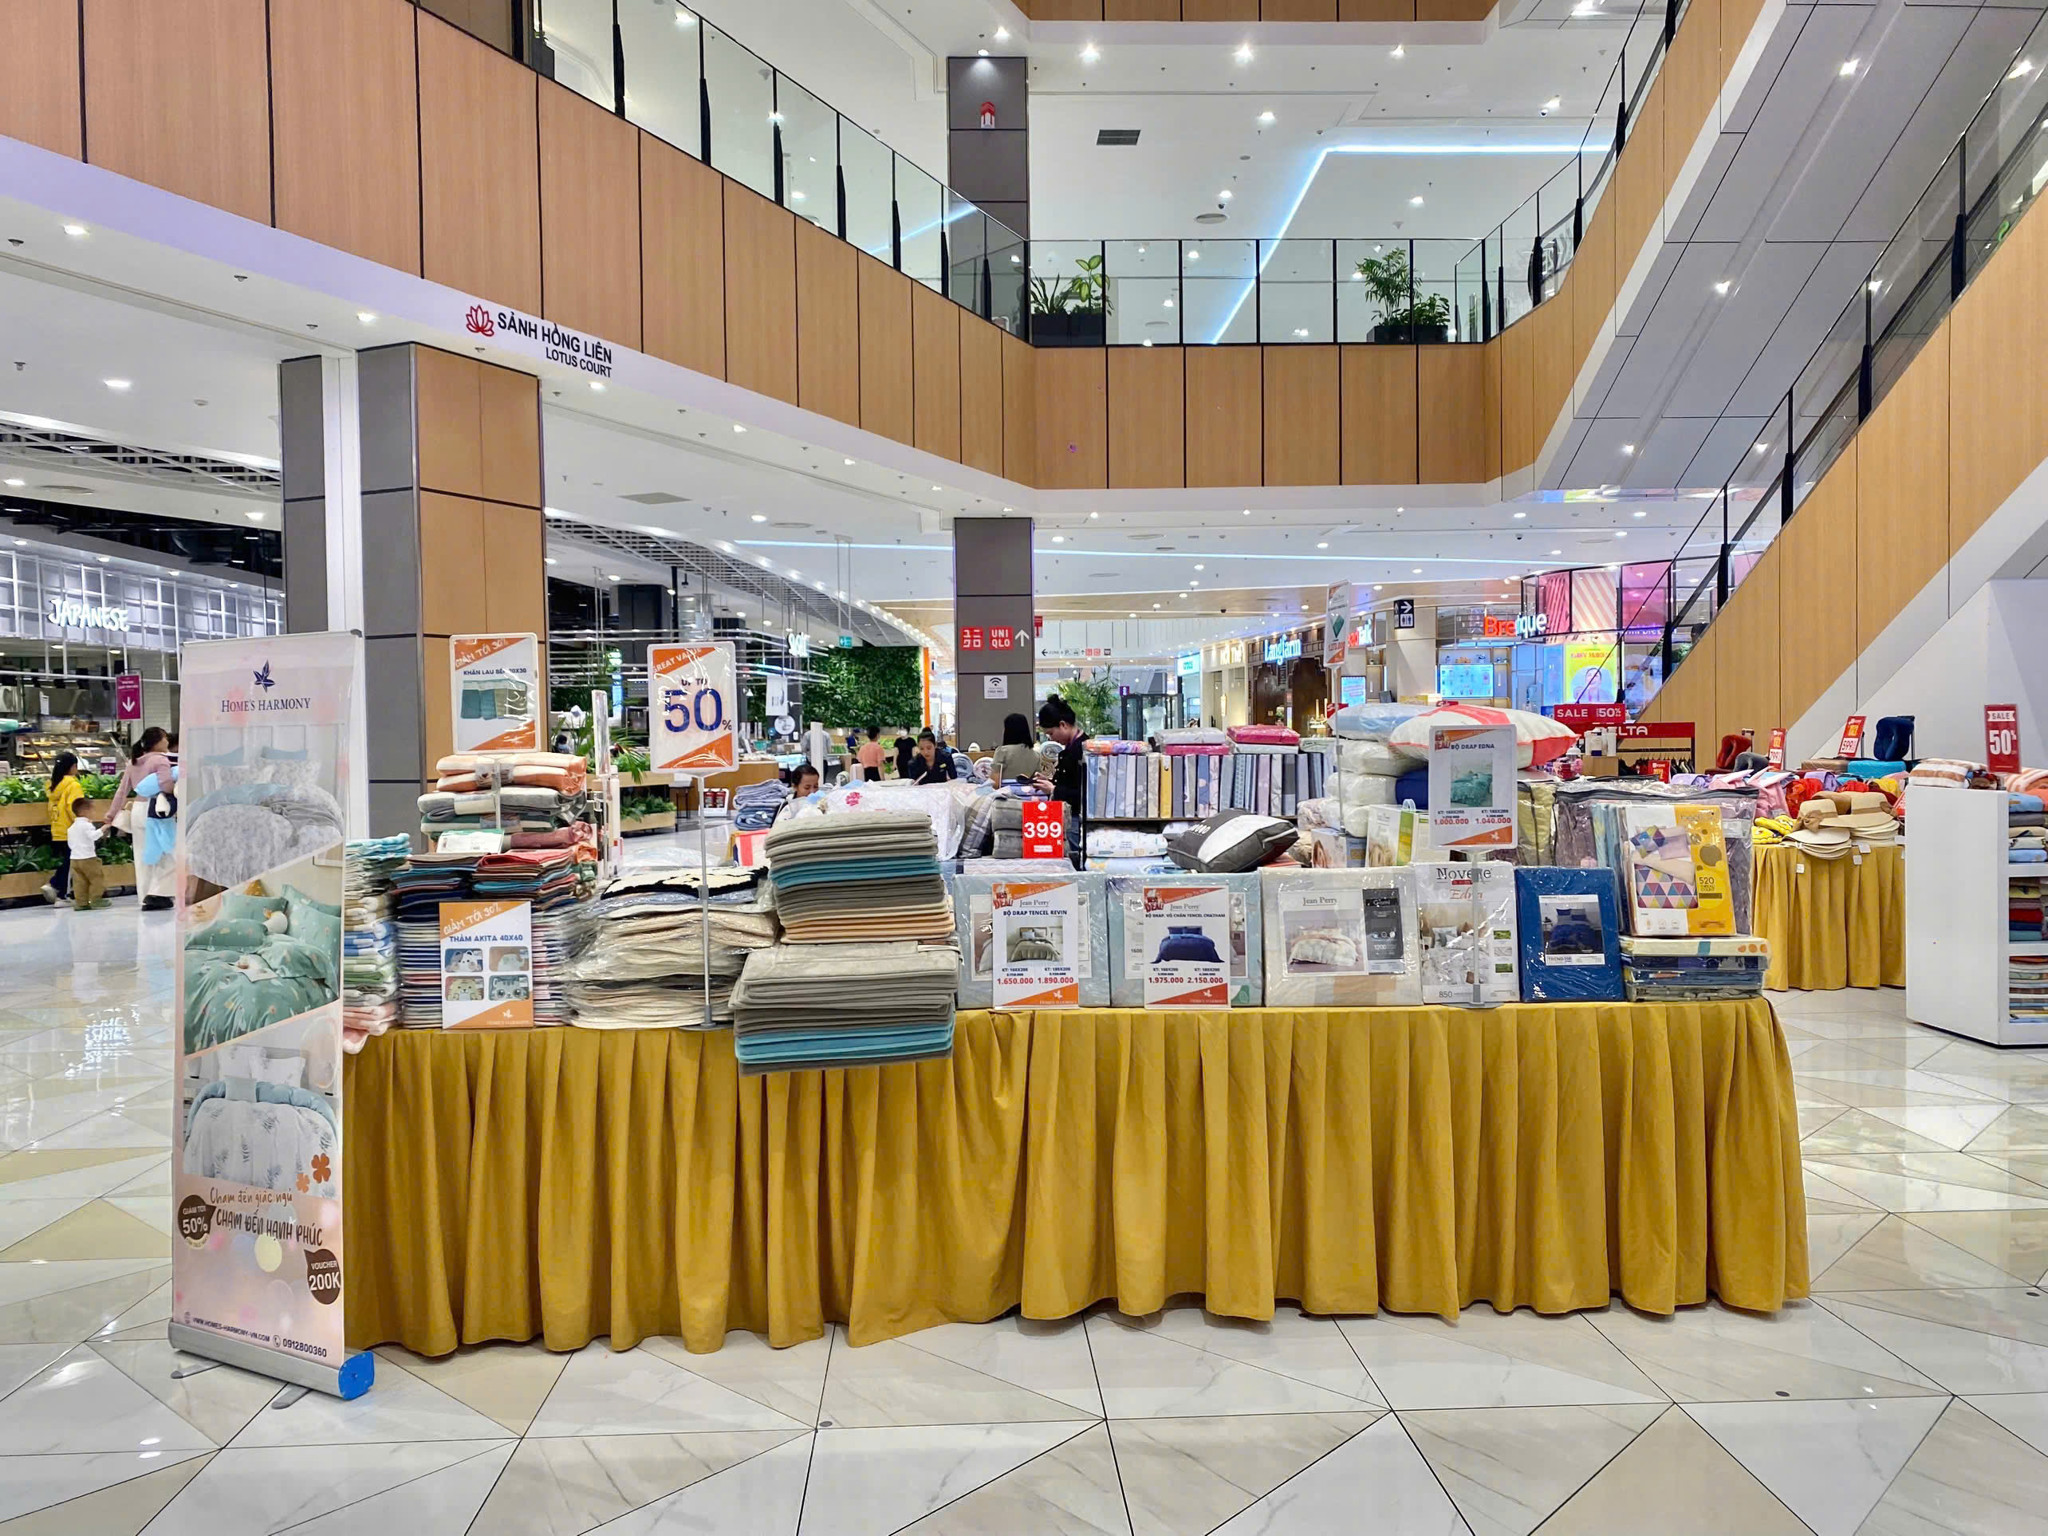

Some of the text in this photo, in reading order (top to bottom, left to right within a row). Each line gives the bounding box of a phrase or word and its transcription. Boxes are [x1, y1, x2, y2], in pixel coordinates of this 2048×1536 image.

[497, 311, 612, 364] SẢNH HỒNG LIÊN
[545, 346, 612, 378] LOTUS COURT
[47, 598, 130, 632] JAPANESE
[991, 629, 1009, 638] UNI
[991, 640, 1011, 649] QLO
[1264, 634, 1302, 665] Langfarm
[653, 657, 676, 673] GREAT
[695, 678, 708, 686] TO
[221, 697, 311, 713] HOME'S HARMONY
[664, 687, 733, 733] 50%
[1556, 708, 1589, 718] SALE
[1991, 712, 2010, 720] SALE
[1989, 729, 2017, 755] 50%
[1023, 821, 1062, 839] 399
[1698, 876, 1715, 885] 520
[1302, 898, 1318, 906] Jean
[443, 918, 465, 935] GIẢM
[465, 908, 482, 925] TỚI
[449, 933, 524, 943] THẢM AKITA 40X60
[997, 977, 1034, 985] 1.650.000
[1037, 976, 1074, 984] 1.890.000
[1148, 976, 1184, 984] 1.975.000
[1187, 976, 1223, 984] 2.150.000
[182, 1217, 209, 1235] 50%
[216, 1208, 324, 1247] CHẠM ĐẾN HẠNH PHÚC
[310, 1260, 338, 1271] VOUCHER
[309, 1271, 341, 1292] 200K
[282, 1338, 328, 1358] 0912800360
